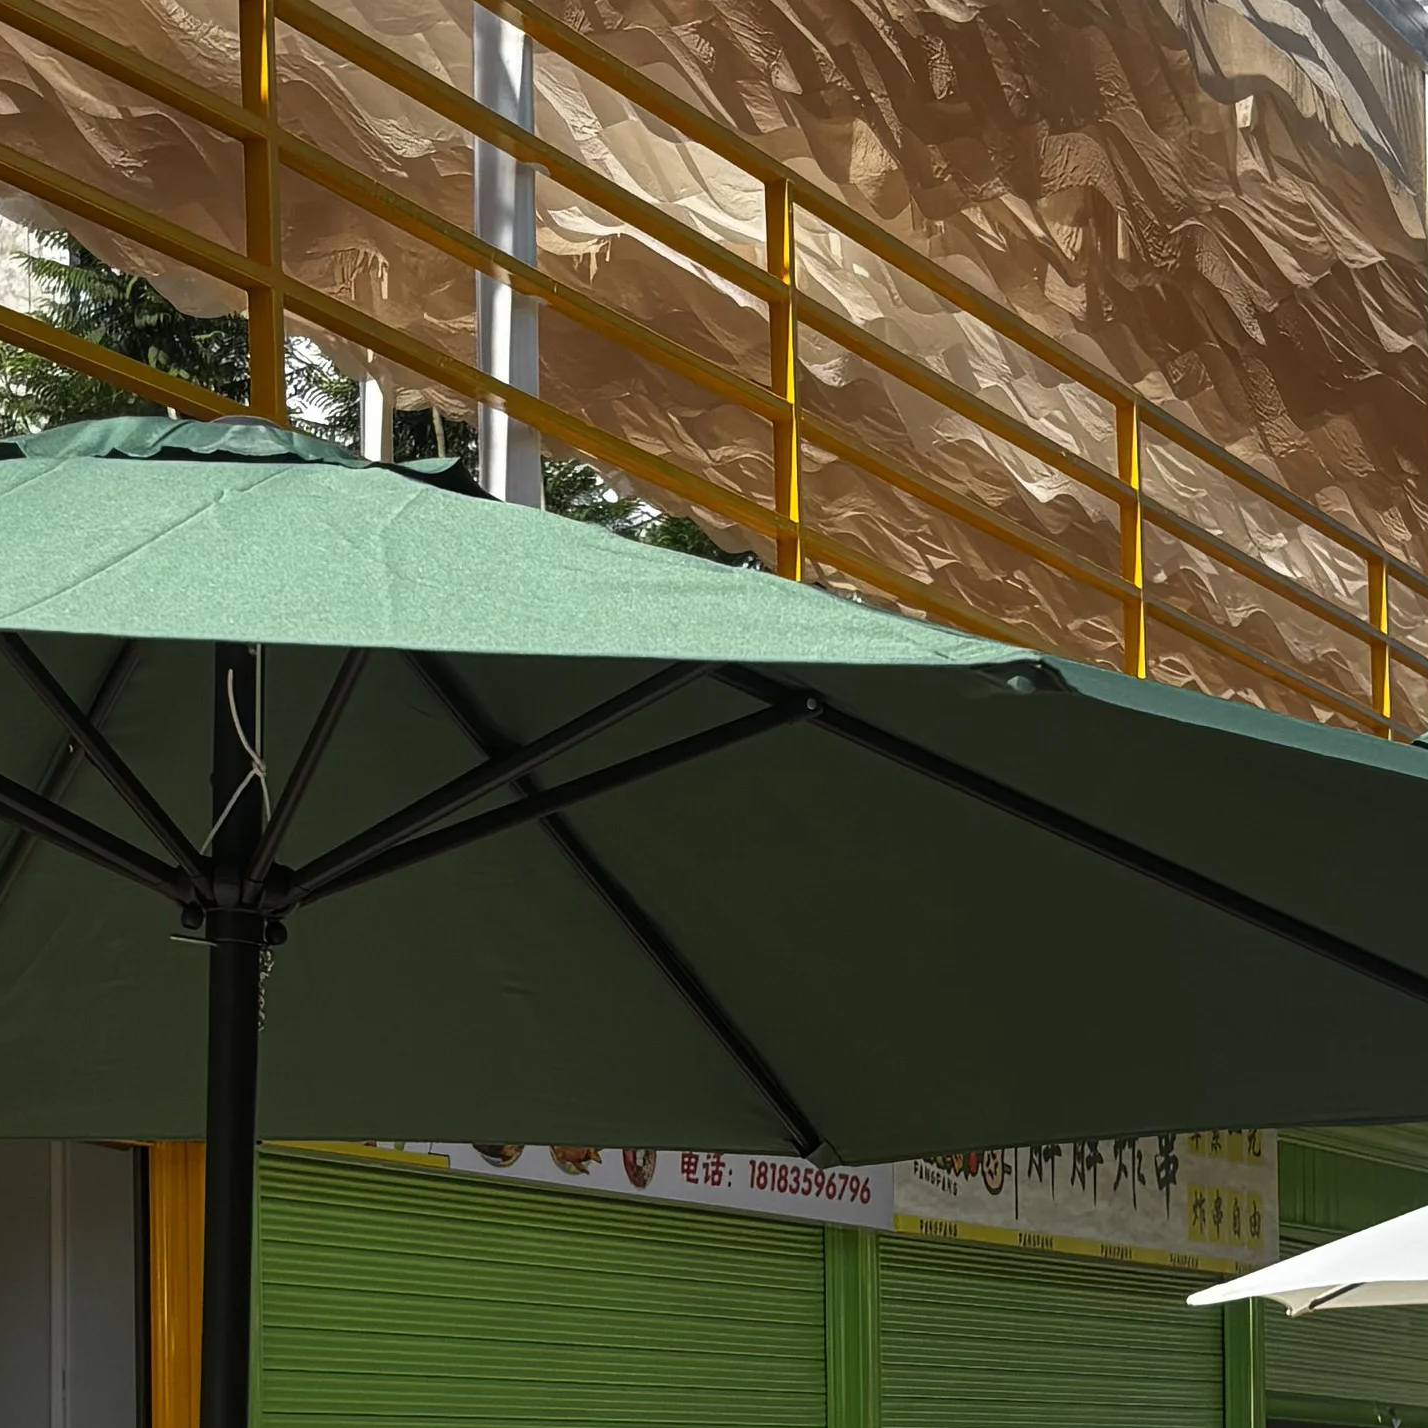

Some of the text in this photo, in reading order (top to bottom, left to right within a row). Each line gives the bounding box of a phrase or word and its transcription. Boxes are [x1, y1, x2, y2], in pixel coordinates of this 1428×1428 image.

[749, 1159, 871, 1204] 18183596796
[1191, 1189, 1261, 1240] 炸串自由
